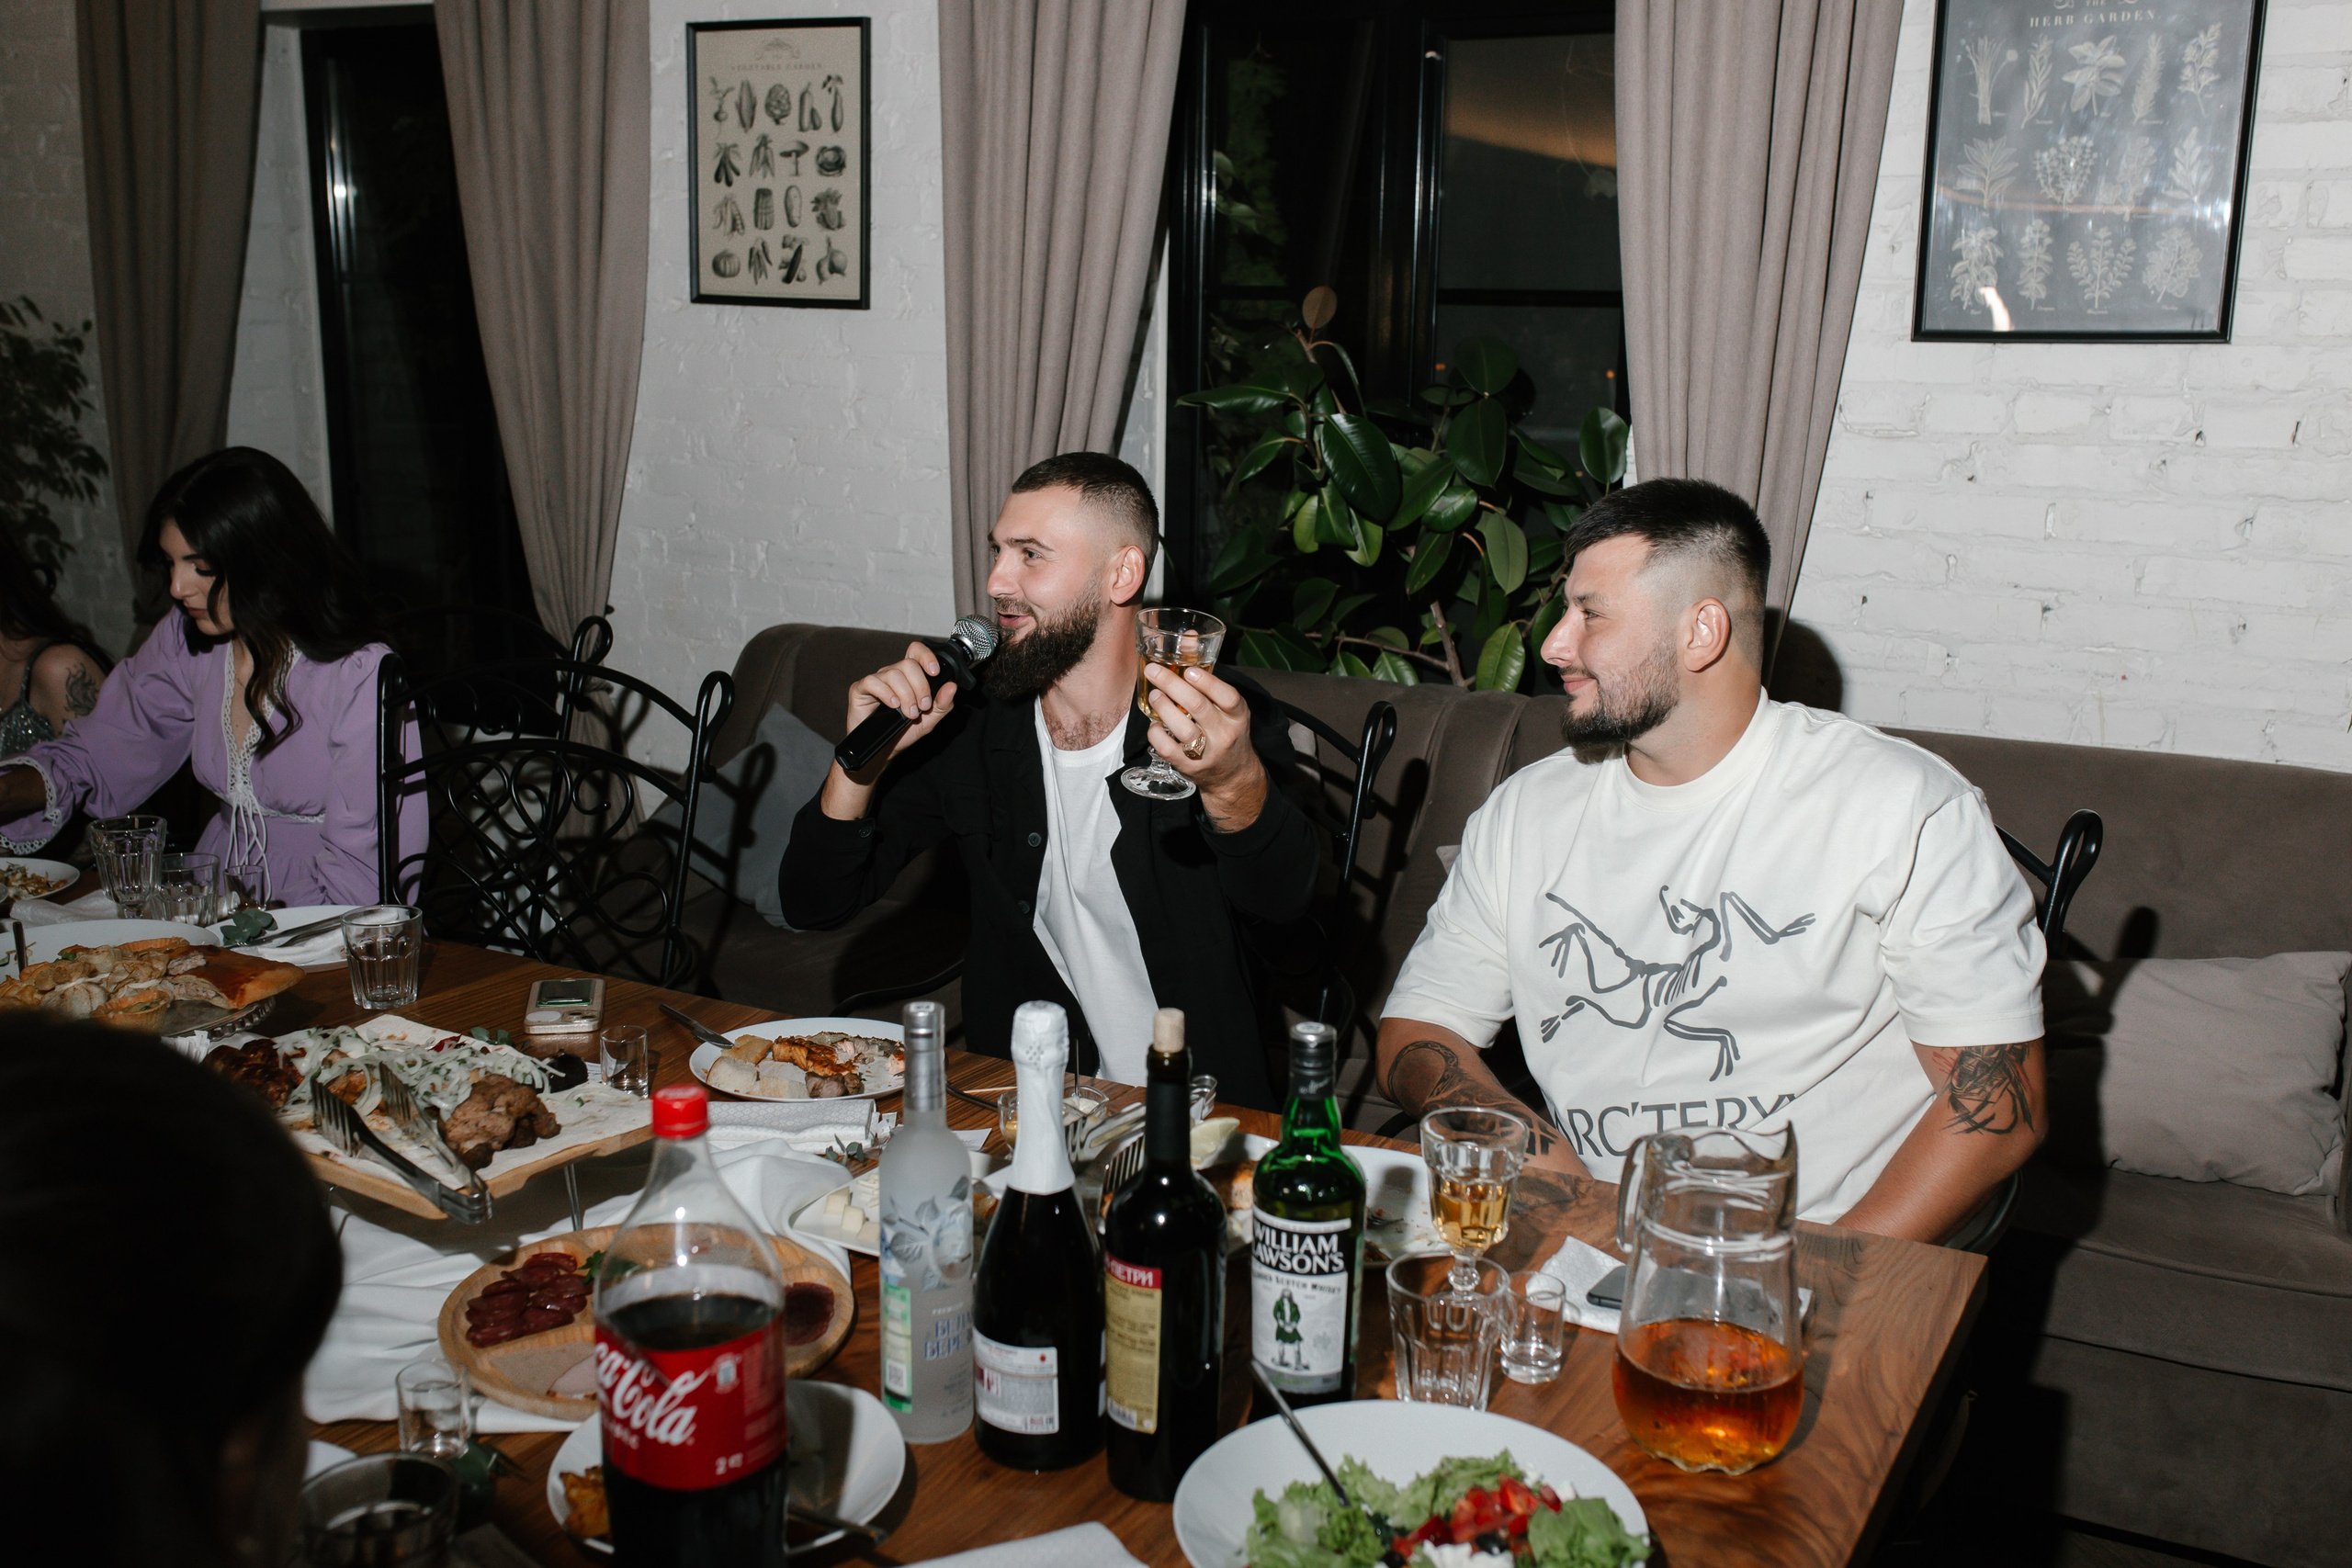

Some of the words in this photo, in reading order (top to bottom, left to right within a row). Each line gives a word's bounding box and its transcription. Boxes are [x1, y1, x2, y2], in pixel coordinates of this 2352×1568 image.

[2030, 15, 2075, 28] HERB
[1554, 1093, 1796, 1157] ARC'TERY
[1253, 1219, 1339, 1256] WILLIAM
[1110, 1259, 1154, 1287] ПЕТРИ
